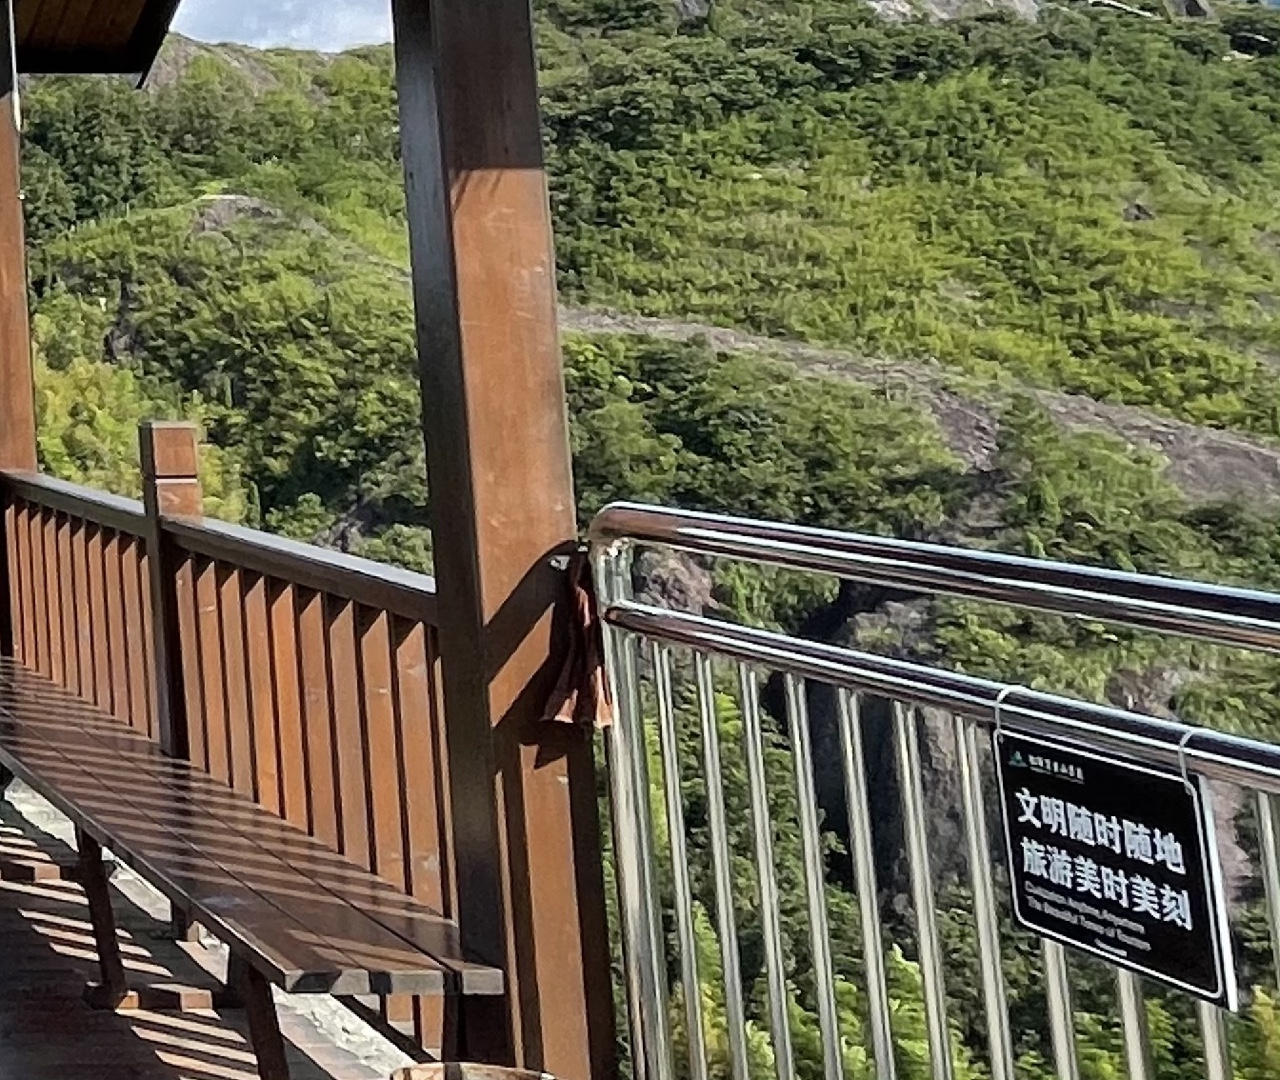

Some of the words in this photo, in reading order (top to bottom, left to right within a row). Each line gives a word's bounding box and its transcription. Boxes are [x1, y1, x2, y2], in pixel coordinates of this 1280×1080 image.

[1015, 786, 1186, 876] 文明随时随地
[1020, 835, 1193, 931] 旅游美时美刻
